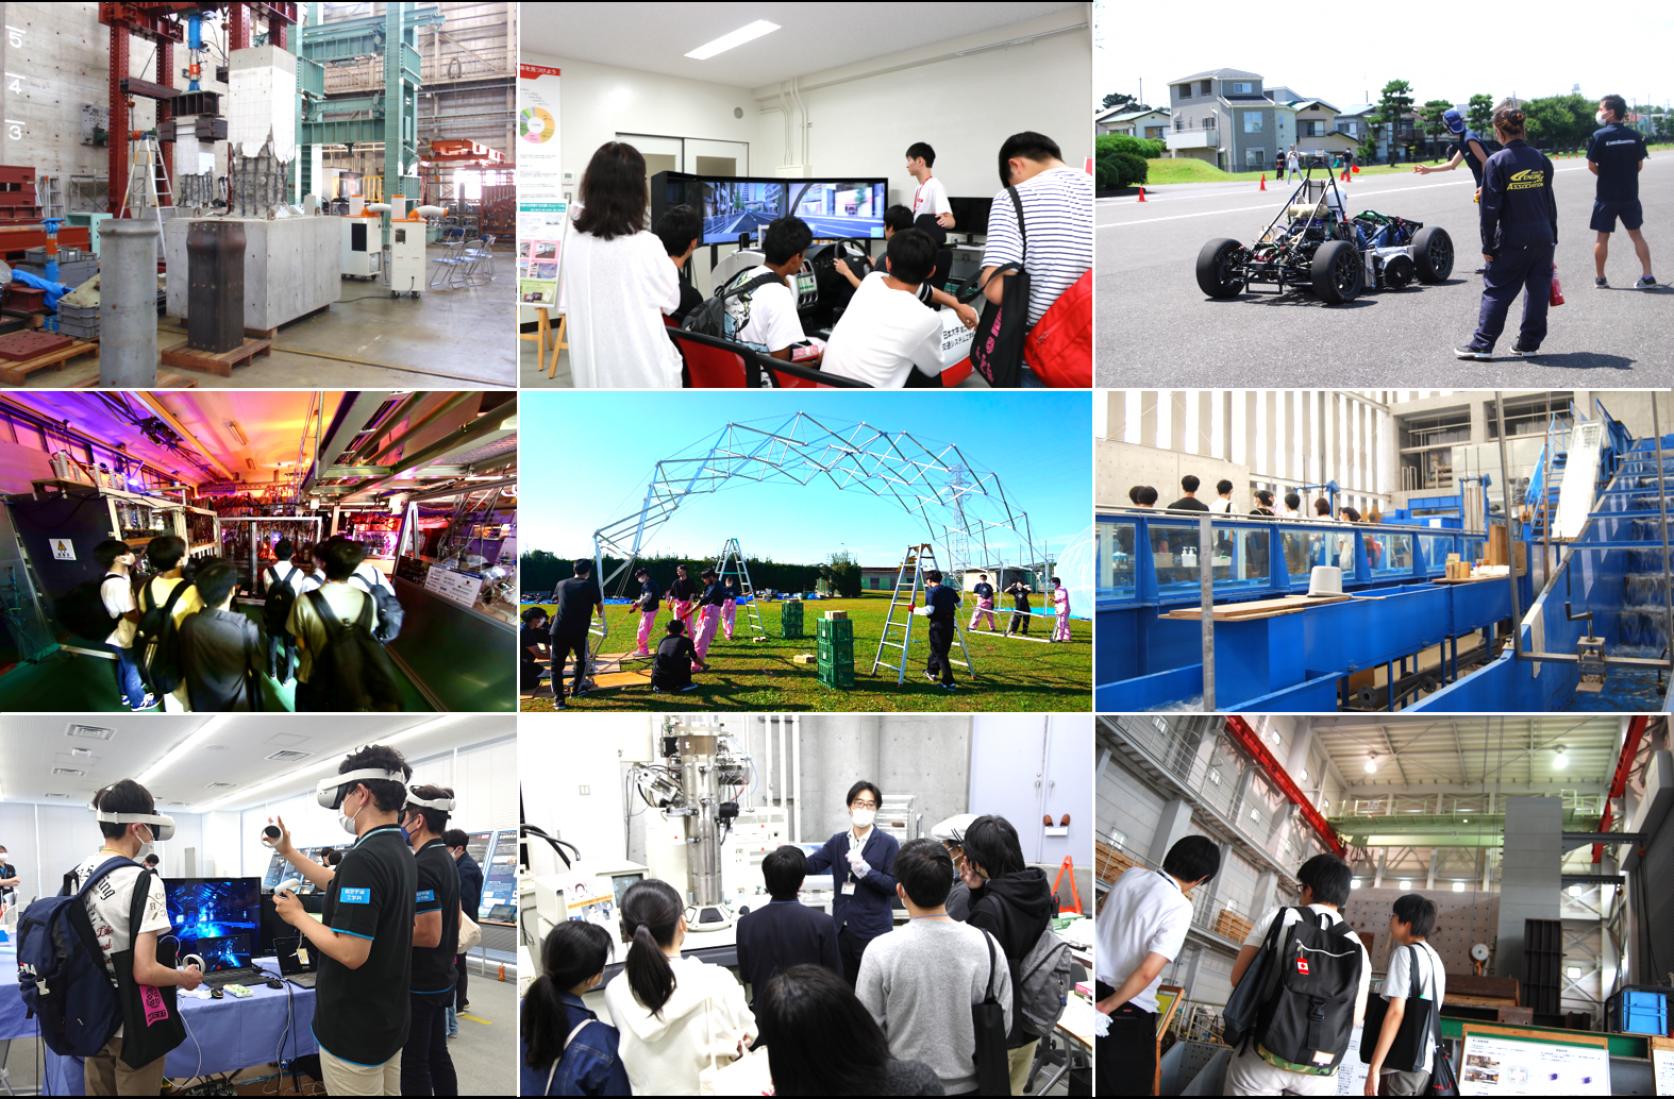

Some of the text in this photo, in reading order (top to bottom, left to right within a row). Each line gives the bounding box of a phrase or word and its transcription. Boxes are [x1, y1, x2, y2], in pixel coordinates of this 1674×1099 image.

[9, 32, 22, 48] 5
[8, 79, 22, 95] 4
[8, 125, 22, 140] 3
[98, 875, 116, 900] ing
